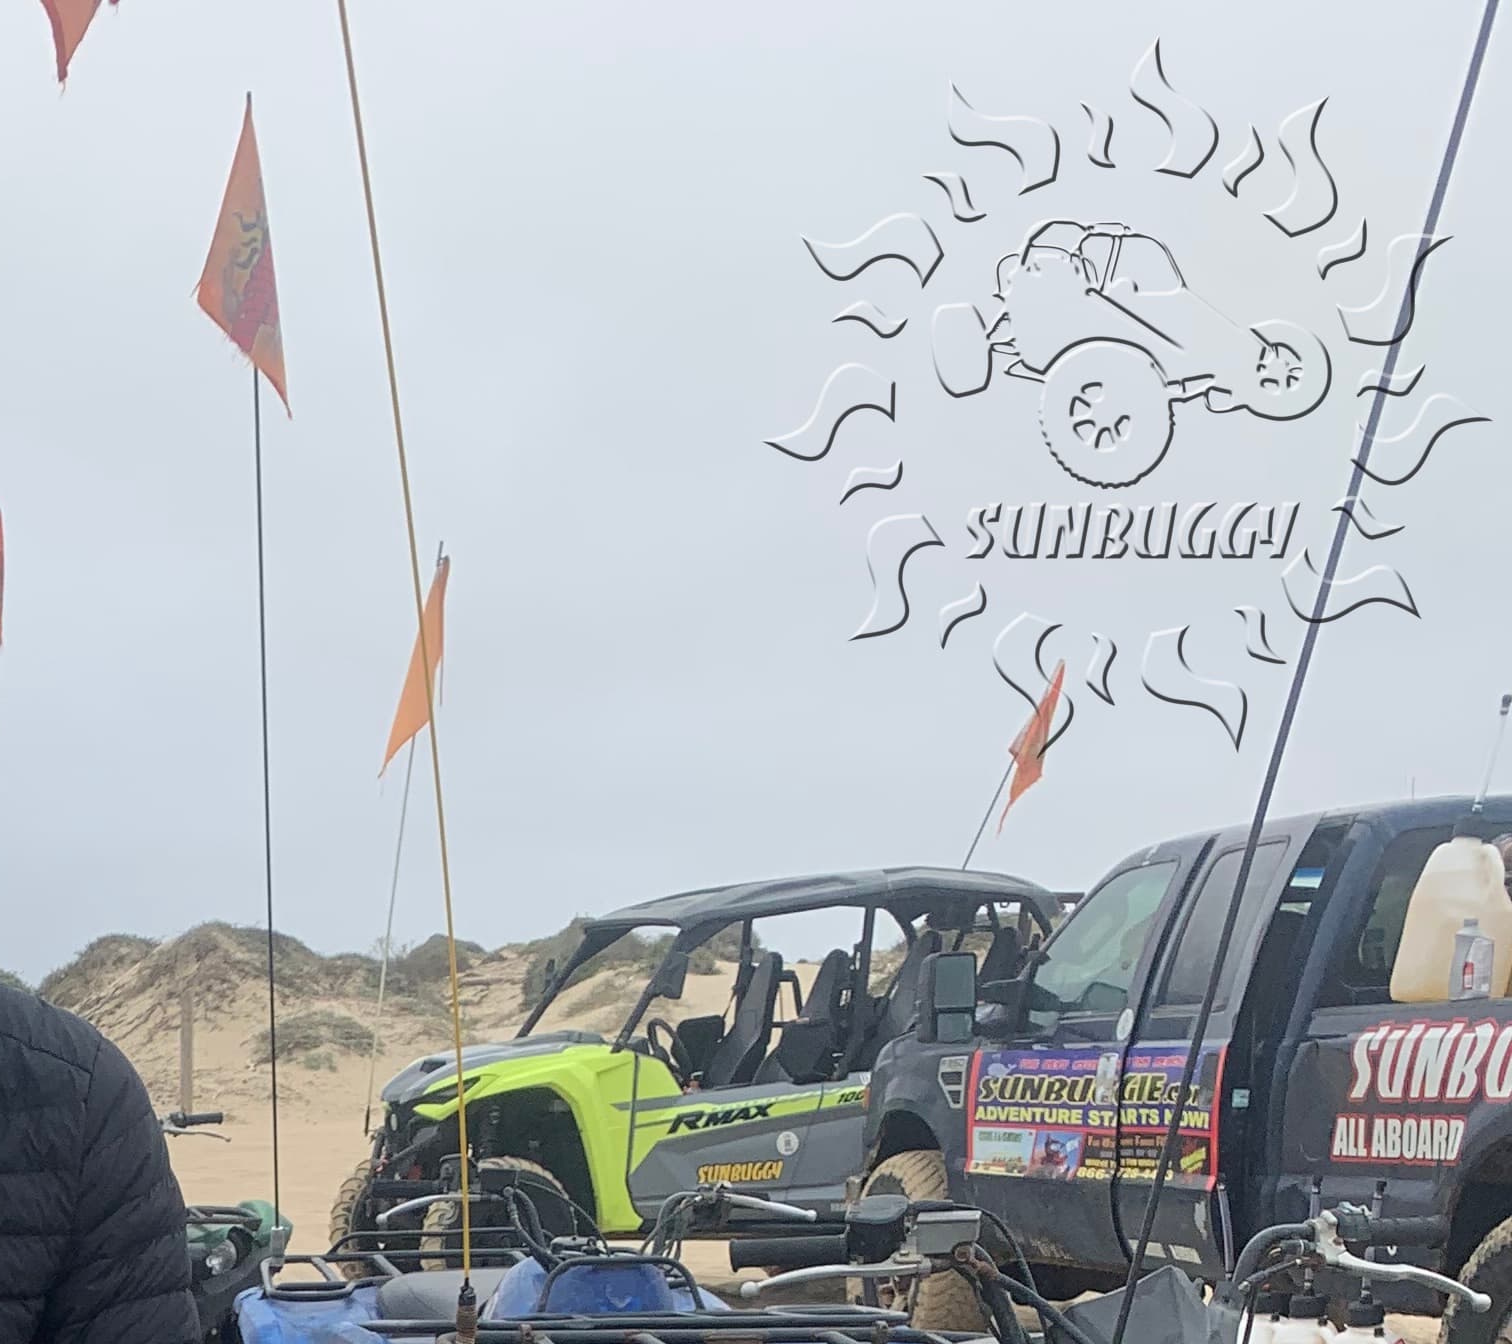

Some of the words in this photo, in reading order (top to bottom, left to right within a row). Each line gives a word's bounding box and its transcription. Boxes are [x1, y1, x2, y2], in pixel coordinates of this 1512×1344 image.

[667, 1102, 776, 1134] RMAX
[975, 1106, 1083, 1125] ADVENTURE
[1332, 1116, 1368, 1157] ALL
[1371, 1117, 1465, 1161] ABOARD
[697, 1160, 784, 1184] SUNBUGGY
